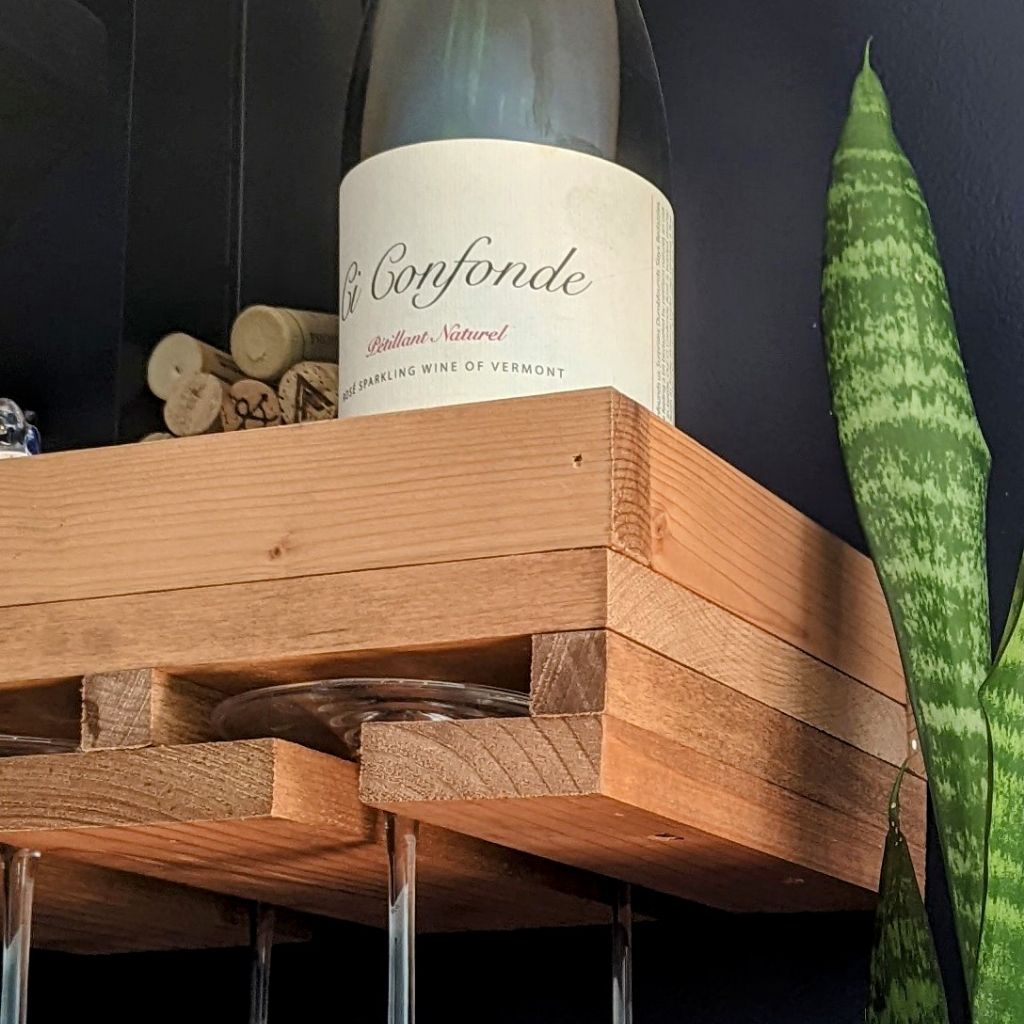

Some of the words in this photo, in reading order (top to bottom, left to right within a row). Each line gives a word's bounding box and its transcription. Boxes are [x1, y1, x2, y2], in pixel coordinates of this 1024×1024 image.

[341, 261, 362, 322] Ci
[371, 236, 593, 310] Confonde
[365, 331, 428, 358] Pétillant
[430, 323, 511, 344] Naturel
[358, 364, 416, 392] SPARKLING
[421, 361, 458, 375] WINE
[465, 360, 485, 373] OF
[491, 361, 566, 379] VERMONT
